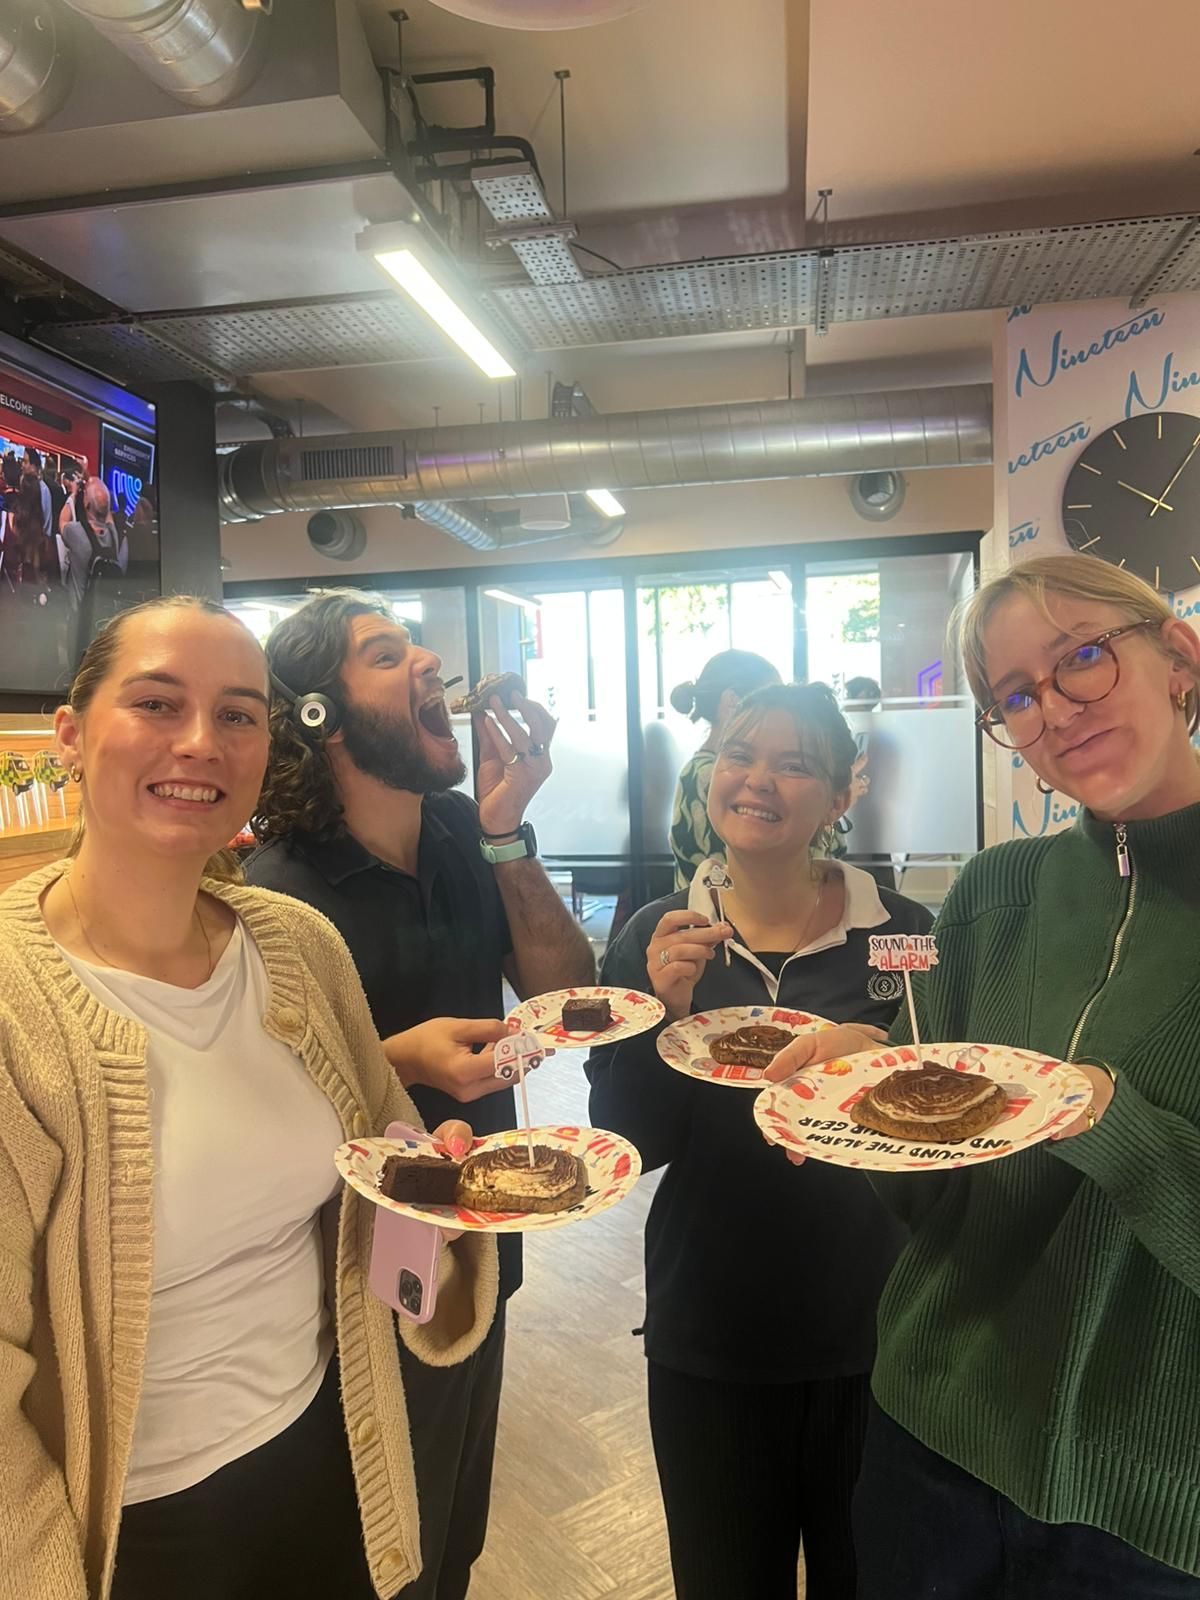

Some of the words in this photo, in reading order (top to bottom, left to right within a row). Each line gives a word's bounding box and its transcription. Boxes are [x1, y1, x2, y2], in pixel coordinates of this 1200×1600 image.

[1015, 307, 1165, 397] Nineteen
[871, 937, 908, 951] SOUND
[911, 937, 935, 951] THE
[880, 949, 929, 970] ALARM
[798, 1117, 849, 1131] GEAR
[805, 1133, 866, 1148] ALARM
[865, 1141, 905, 1154] THE
[909, 1147, 975, 1159] OUND
